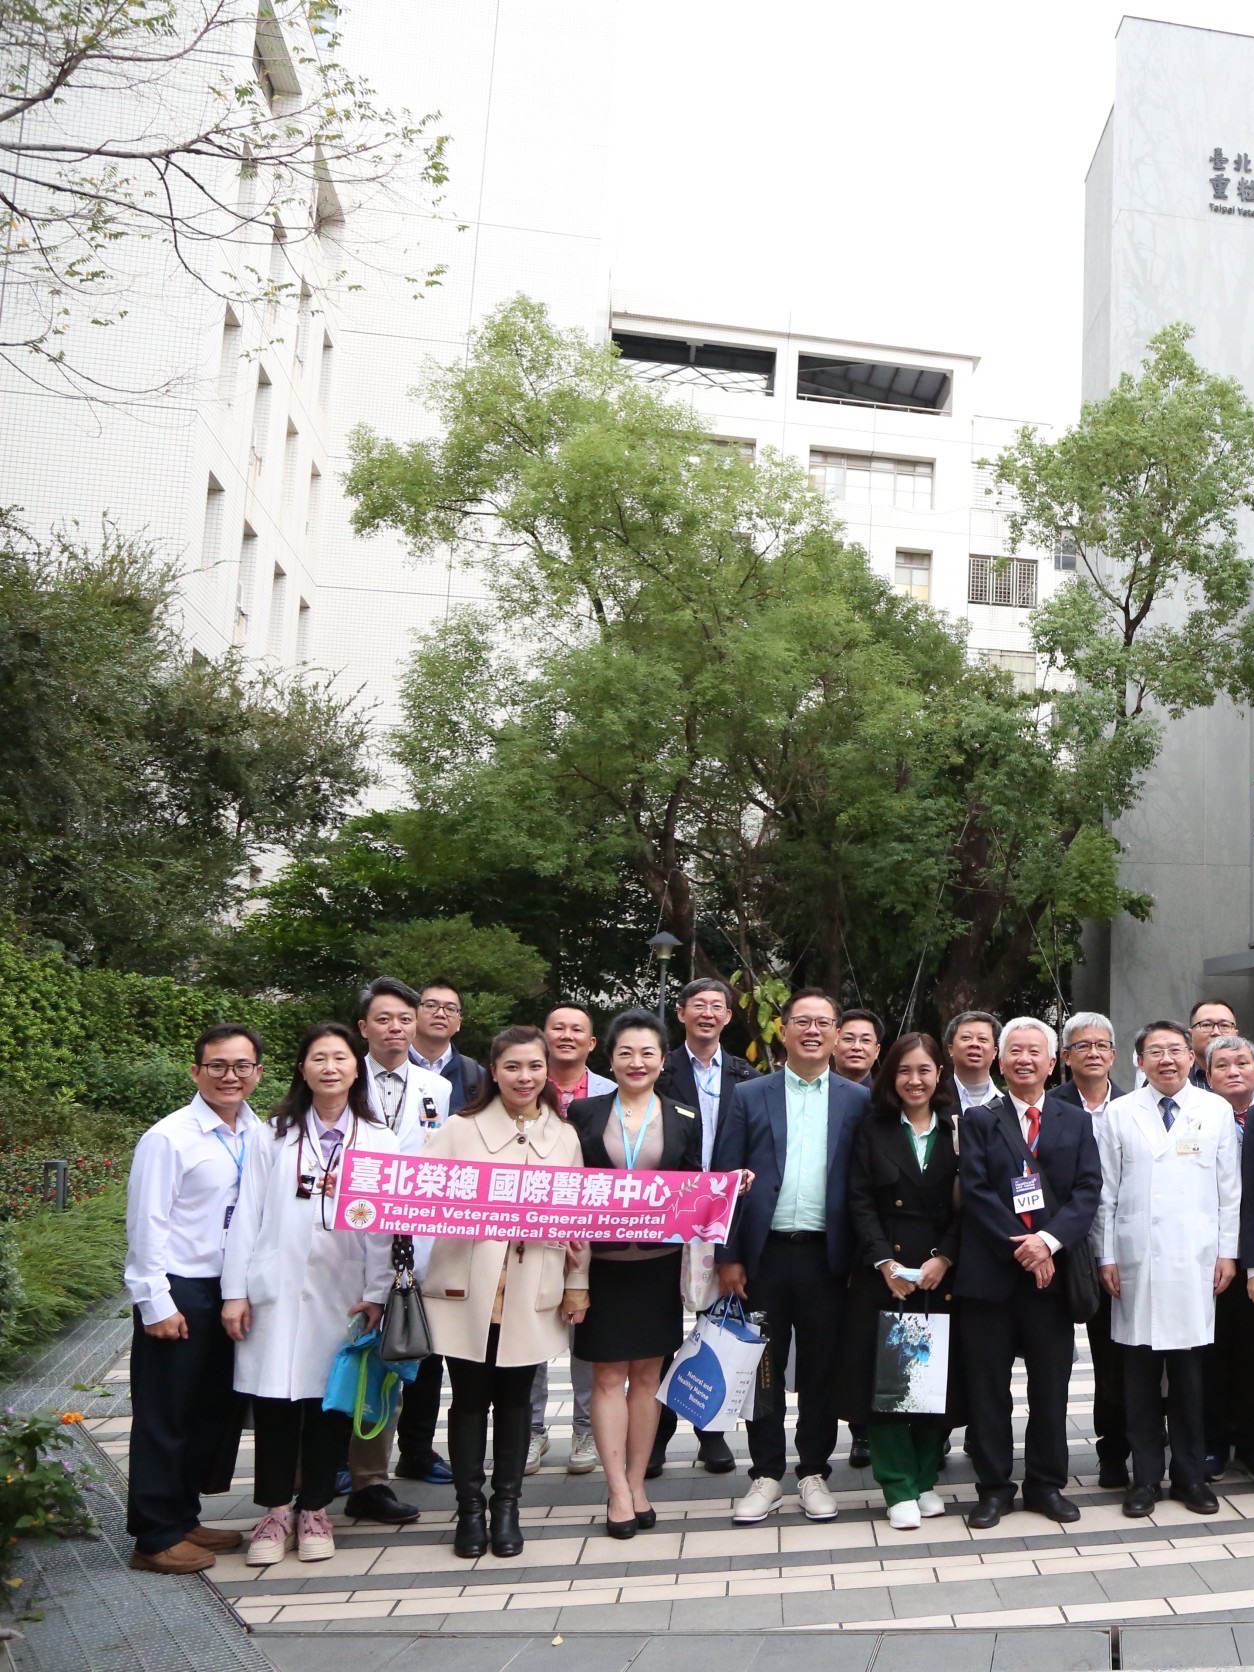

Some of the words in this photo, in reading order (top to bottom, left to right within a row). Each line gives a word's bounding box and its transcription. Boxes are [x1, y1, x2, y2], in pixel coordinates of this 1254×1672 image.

[1209, 203, 1235, 215] Taipei
[348, 1157, 480, 1201] 臺北榮總
[487, 1168, 672, 1208] 國際醫療中心
[1017, 1195, 1039, 1207] VIP
[381, 1202, 436, 1219] Taipei
[441, 1206, 520, 1222] Veterans
[525, 1211, 593, 1226] General
[597, 1214, 666, 1227] Hospital
[379, 1218, 480, 1236] International
[484, 1225, 543, 1239] Medical
[547, 1227, 611, 1239] Services
[615, 1228, 664, 1239] Center
[677, 1374, 694, 1391] Healthy
[693, 1384, 709, 1401] Marine
[687, 1370, 704, 1387] Natural
[702, 1382, 713, 1393] and
[689, 1393, 706, 1410] Biotech
